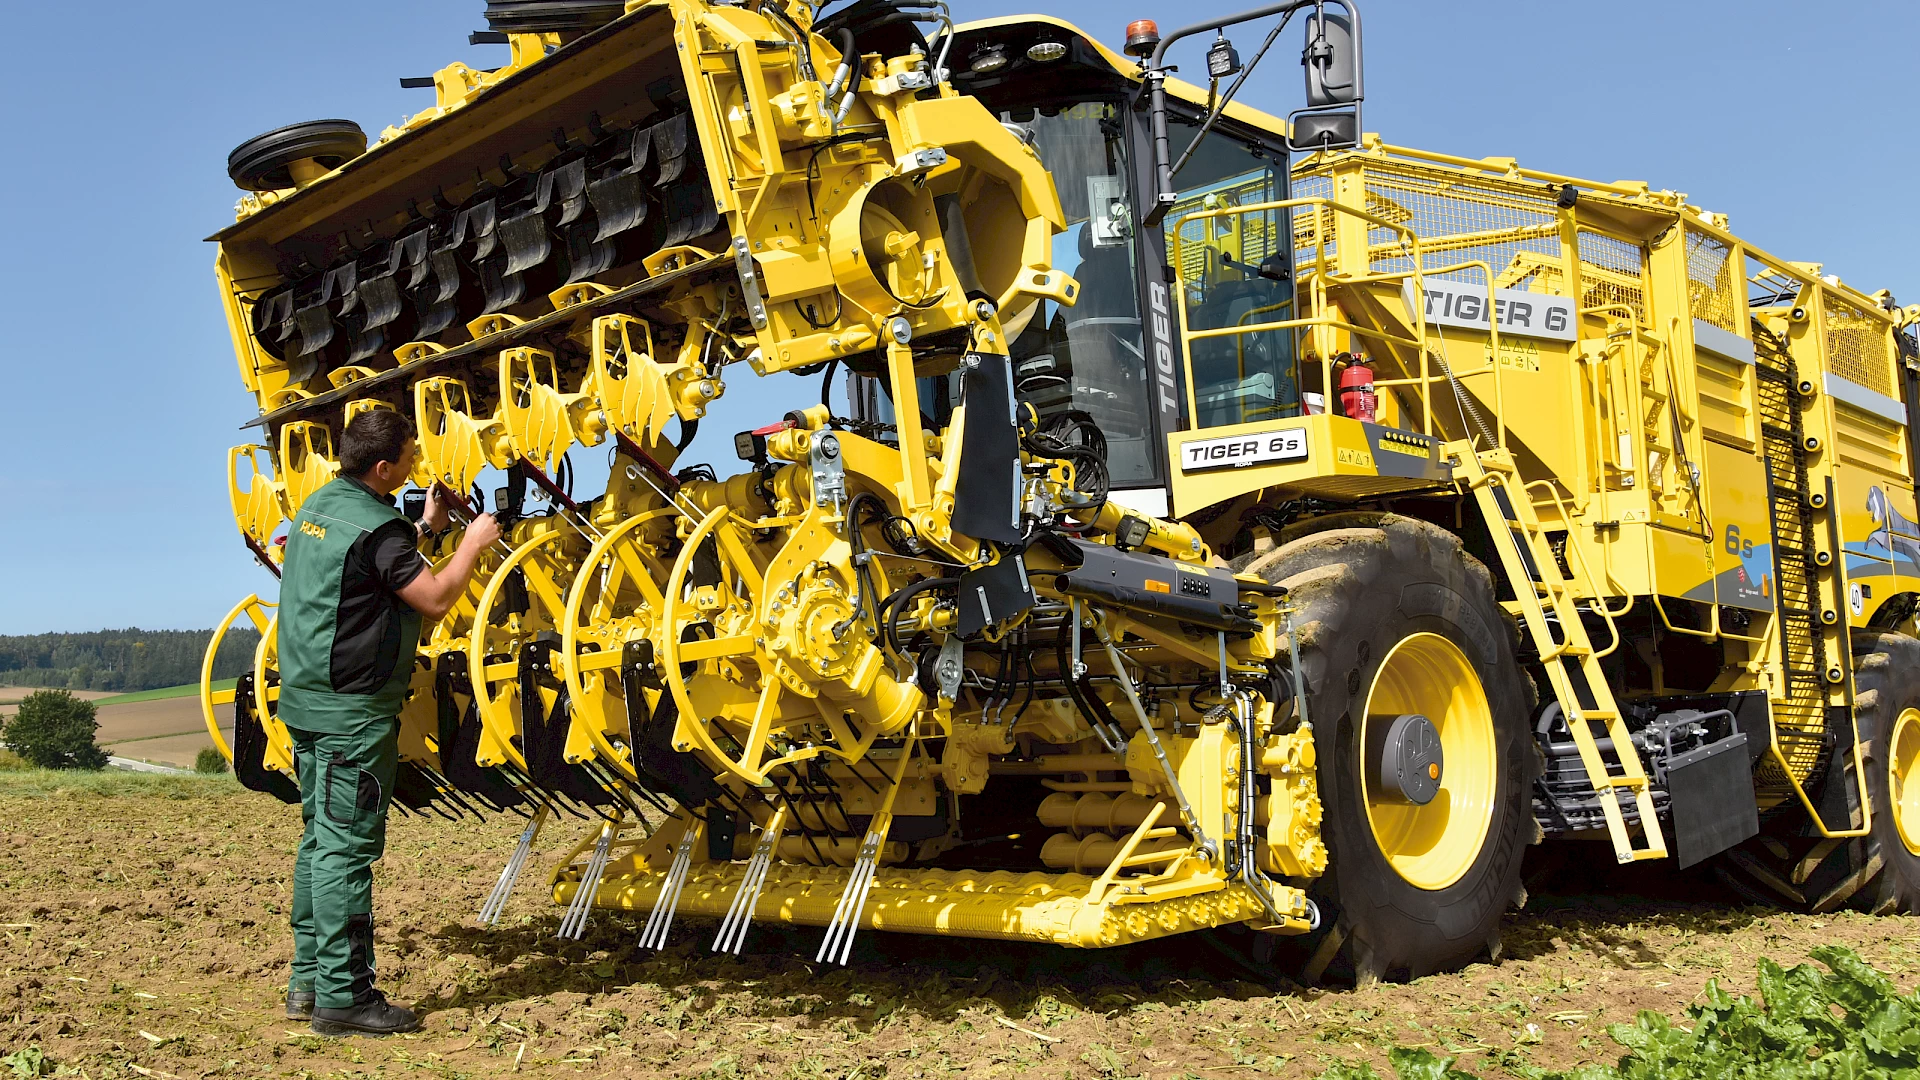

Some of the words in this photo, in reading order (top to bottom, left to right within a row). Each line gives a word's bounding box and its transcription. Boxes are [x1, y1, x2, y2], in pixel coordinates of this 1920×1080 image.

[1423, 289, 1532, 328] TIGER
[1544, 306, 1568, 332] 6
[1150, 281, 1176, 413] TIGER
[1189, 441, 1259, 461] TIGER
[1268, 437, 1299, 453] 6s
[300, 520, 326, 540] ROPA
[1725, 523, 1753, 559] 6s
[1851, 588, 1860, 609] 40
